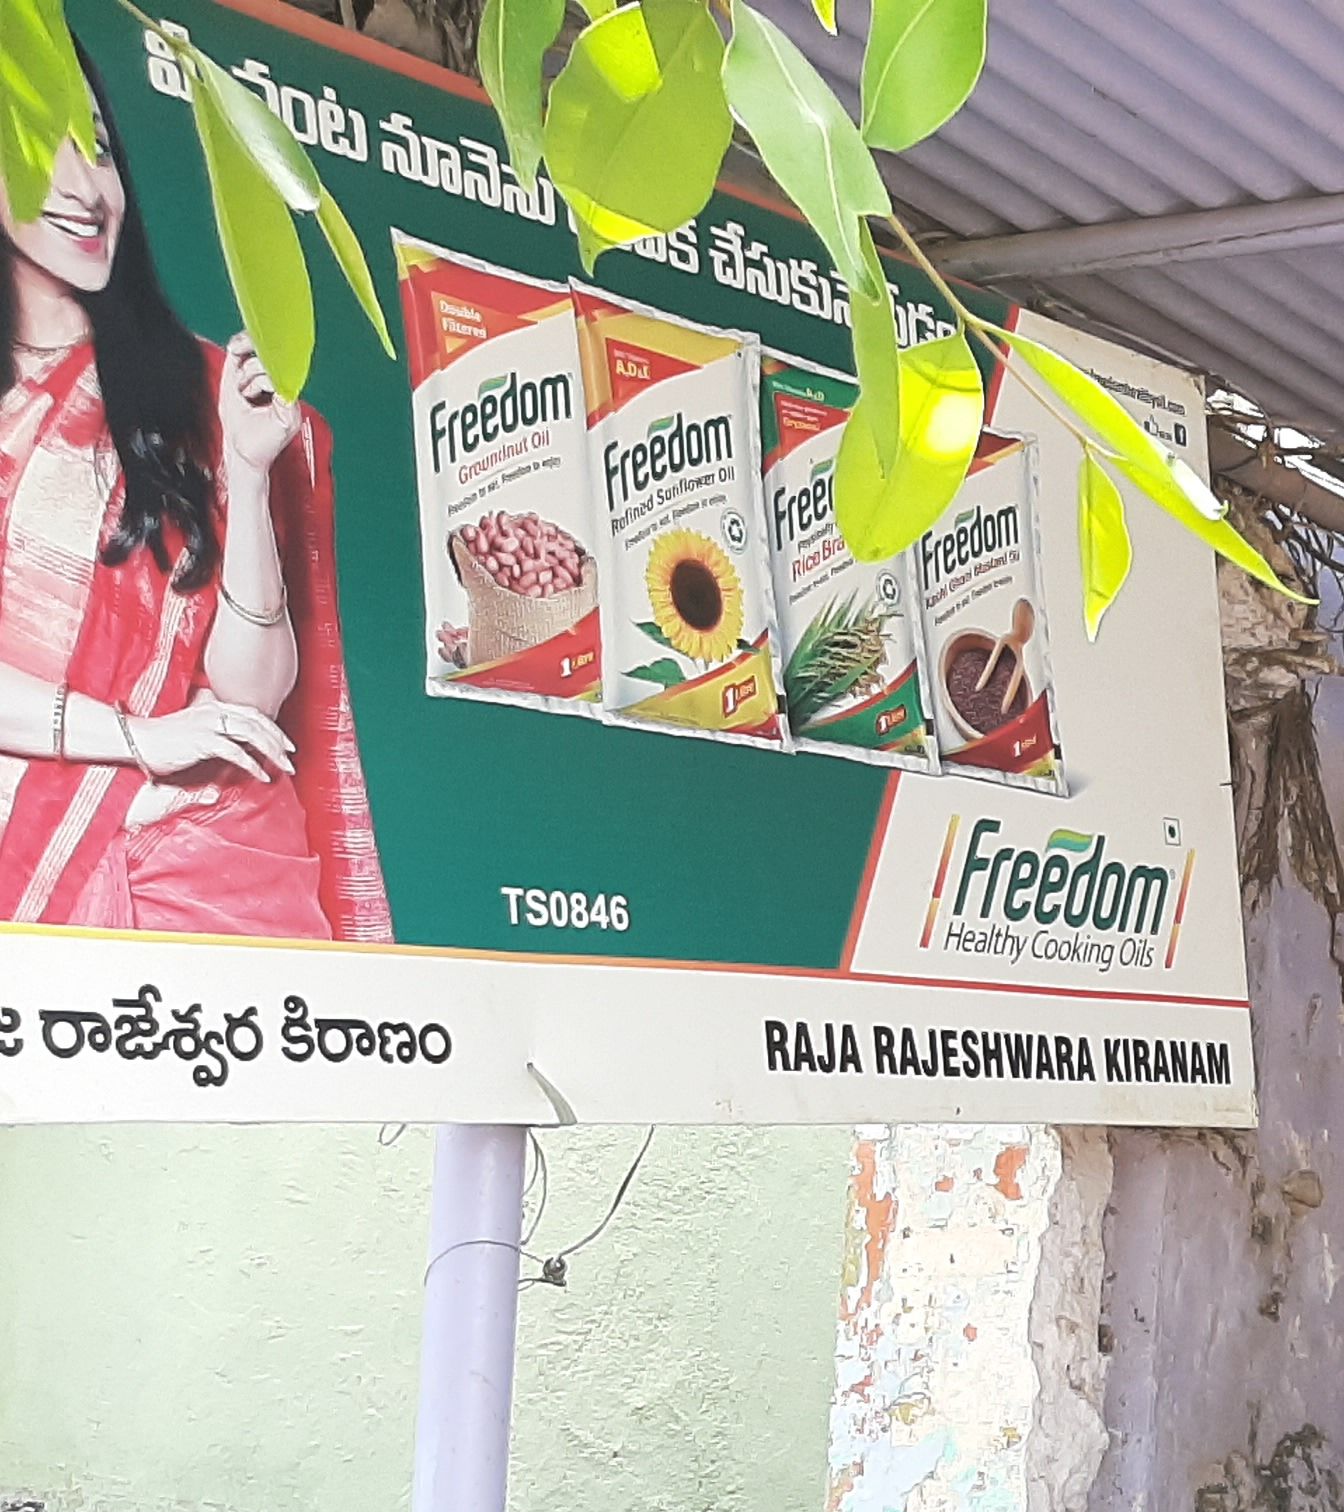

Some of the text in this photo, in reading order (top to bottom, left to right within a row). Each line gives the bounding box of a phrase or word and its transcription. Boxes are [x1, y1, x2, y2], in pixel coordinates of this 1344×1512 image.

[430, 372, 573, 473] Freedom
[458, 429, 551, 485] Groundnut Oil
[604, 412, 733, 513] Freedom
[611, 493, 655, 537] Refined
[718, 466, 736, 484] Oil
[773, 475, 834, 551] Free
[822, 536, 845, 563] Bra
[921, 505, 1019, 590] Freedom
[501, 886, 630, 932] TS0846
[952, 818, 1170, 936] Freedom
[943, 920, 1156, 973] Healthy Cooking Oils
[39, 983, 264, 1088] రాజేశ్వర
[281, 994, 453, 1065] కిరాణం
[764, 1019, 1233, 1086] RAJA RAJESHWARA KIRANAM
